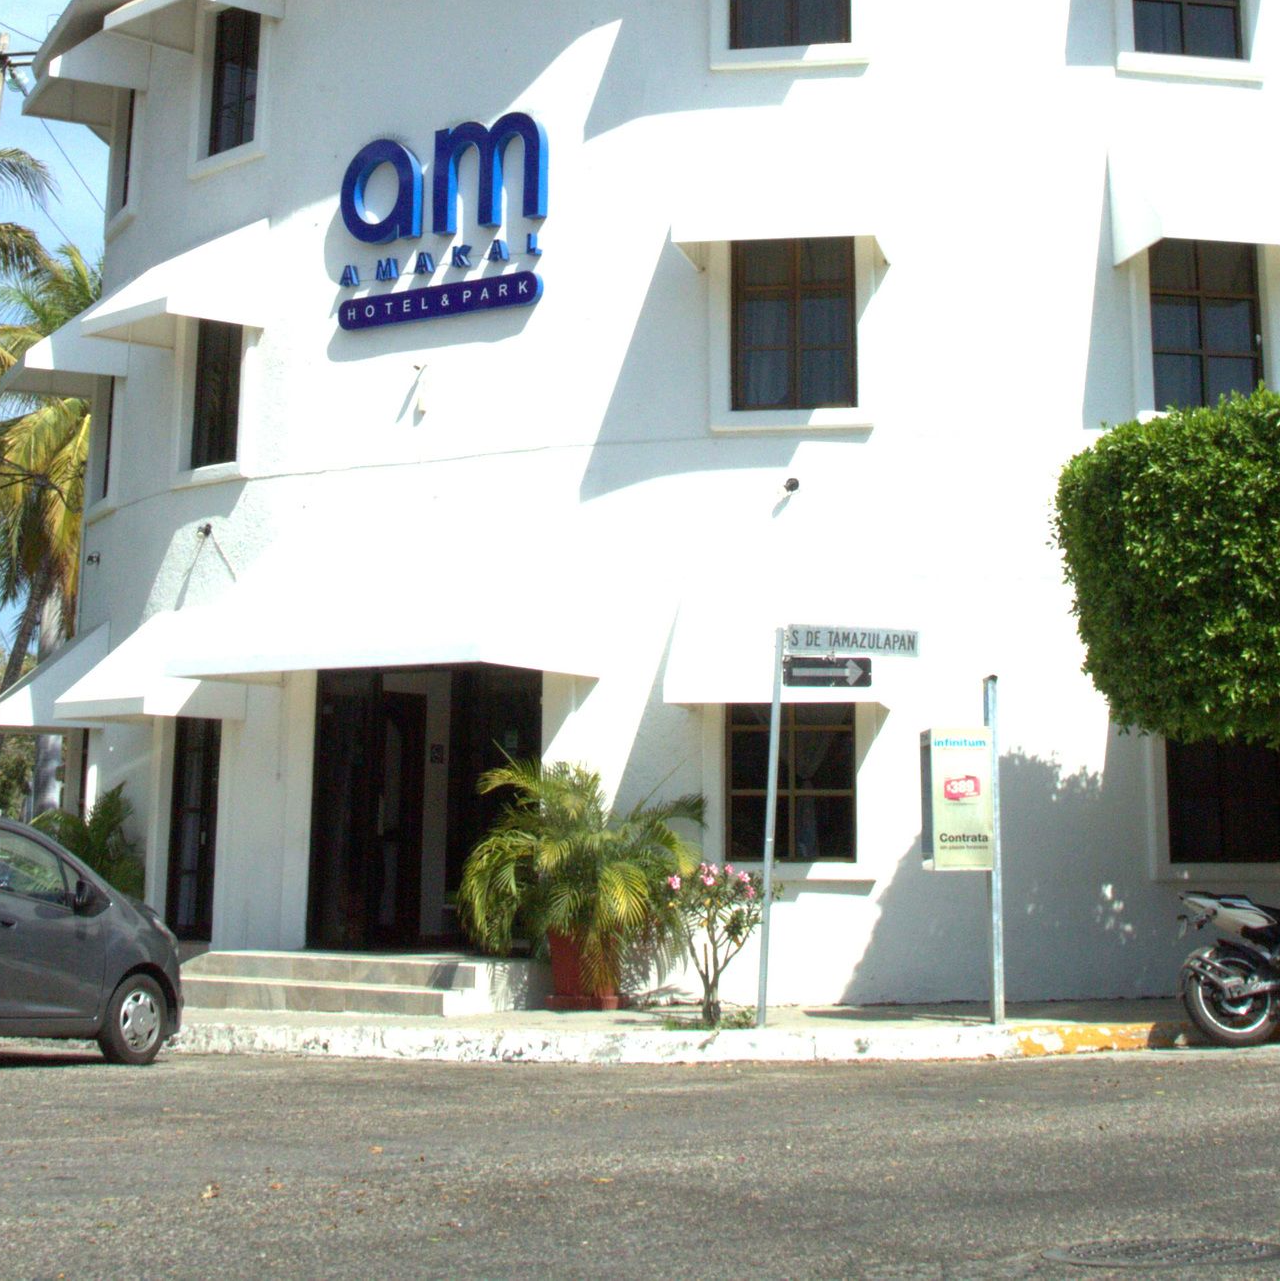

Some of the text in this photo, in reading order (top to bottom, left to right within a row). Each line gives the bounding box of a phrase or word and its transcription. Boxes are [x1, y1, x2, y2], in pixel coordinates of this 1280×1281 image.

[340, 112, 549, 245] am
[339, 232, 543, 288] AMAKAL
[791, 629, 916, 651] S DE TAMAZULAPAN
[939, 832, 989, 843] Contrata
